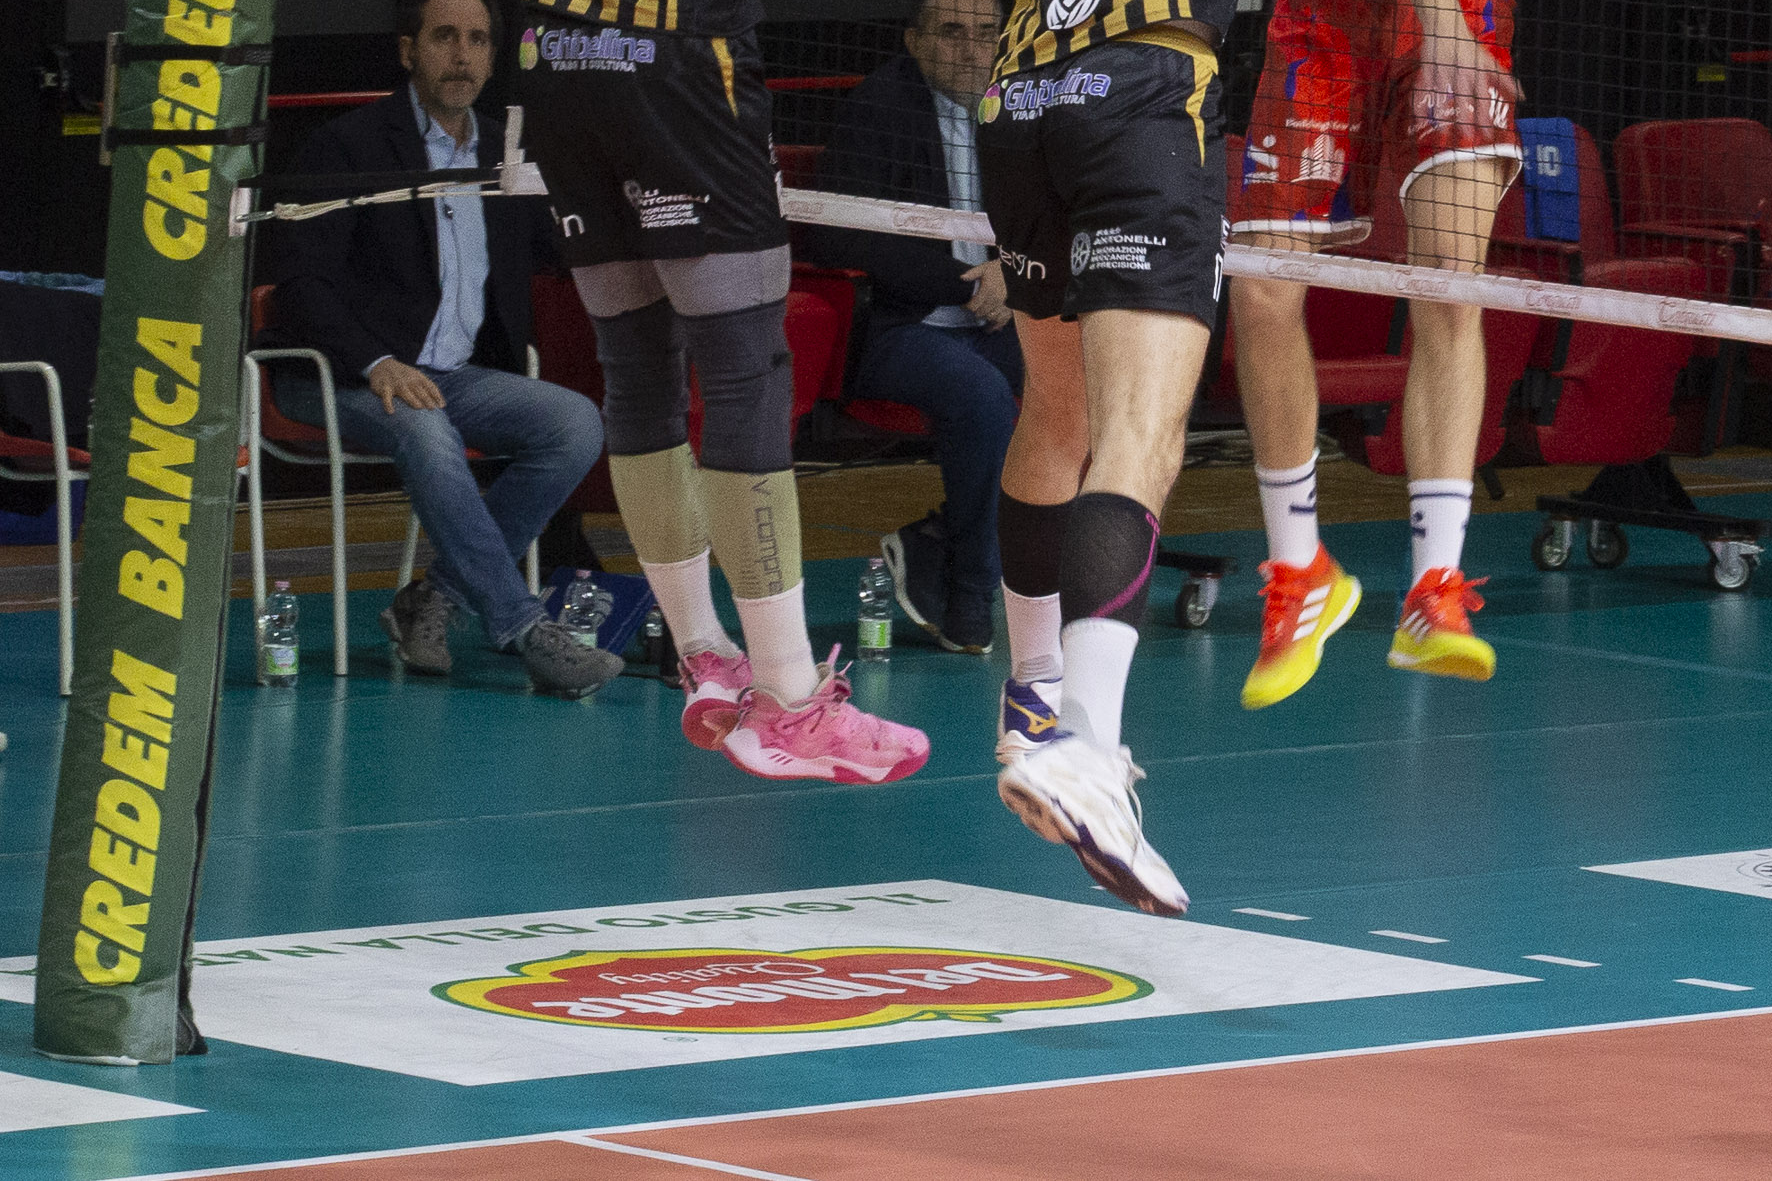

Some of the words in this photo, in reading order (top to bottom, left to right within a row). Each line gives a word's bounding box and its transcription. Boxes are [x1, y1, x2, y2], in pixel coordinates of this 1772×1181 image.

[117, 317, 203, 620] BANCA
[73, 648, 178, 987] CREDEM
[594, 900, 856, 929] GUSTO
[331, 921, 597, 951] DELLA
[596, 959, 828, 989] Quality
[848, 959, 1074, 993] Del
[528, 978, 906, 1019] Monte
